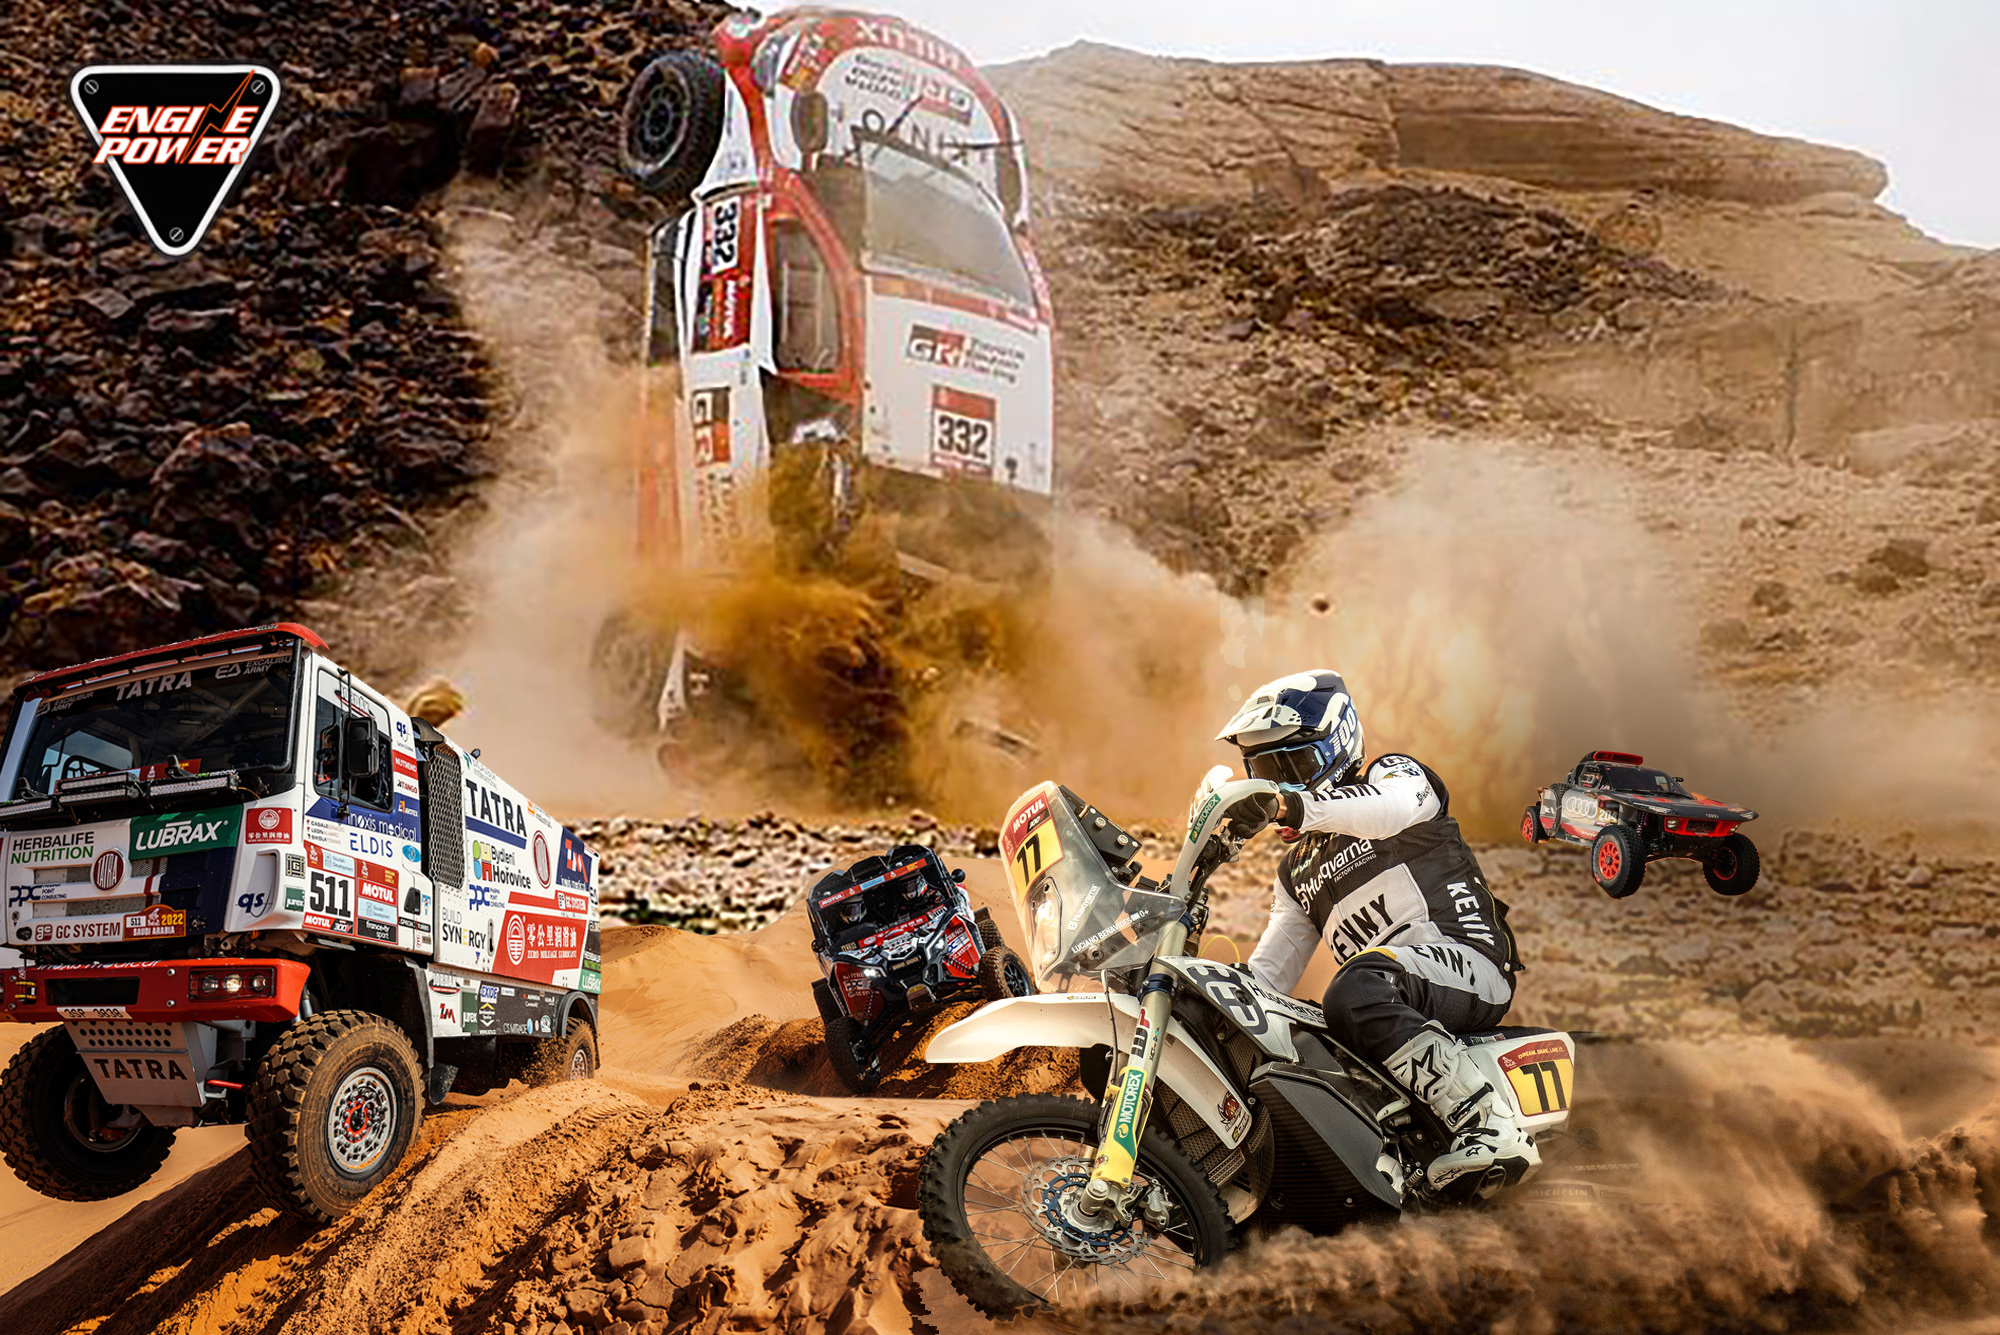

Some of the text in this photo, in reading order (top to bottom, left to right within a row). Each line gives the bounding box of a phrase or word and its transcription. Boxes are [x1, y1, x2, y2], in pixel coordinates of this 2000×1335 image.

[714, 202, 738, 265] 332
[938, 415, 988, 460] 332
[243, 664, 271, 675] ARMY
[116, 671, 192, 701] TATRA
[51, 702, 74, 713] ARMY
[465, 778, 527, 838] TATRA
[1012, 799, 1045, 834] MOTUL
[1195, 796, 1219, 833] MOTOREX
[1599, 809, 1618, 823] 204
[13, 831, 95, 851] HERBALIFE
[135, 820, 223, 850] LUBRAX
[350, 832, 393, 858] ELDIS
[10, 846, 94, 864] NUTRITION
[97, 853, 118, 888] TATRA
[492, 865, 532, 890] Hořovice
[1334, 866, 1355, 883] FACTORY
[238, 892, 265, 913] qs
[310, 871, 351, 918] 511
[362, 882, 395, 903] MOTUL
[821, 894, 843, 906] MOTUL
[130, 913, 184, 926] 511 2022
[305, 915, 331, 928] MOTUL
[442, 907, 462, 925] BUILD
[56, 922, 121, 939] GC SYSTEM
[133, 926, 175, 936] SAUDI ARABIA
[442, 923, 486, 949] SYNERGY
[527, 922, 577, 948] 零公里润滑油
[1071, 936, 1098, 954] LUCIANO
[1097, 917, 1133, 942] BENAVIDES
[481, 986, 498, 999] EXIDE
[64, 1008, 123, 1018] 3SP 3838
[93, 1059, 188, 1080] TATRA
[1519, 1061, 1567, 1112] 77
[1119, 1072, 1143, 1124] MOTOREX
